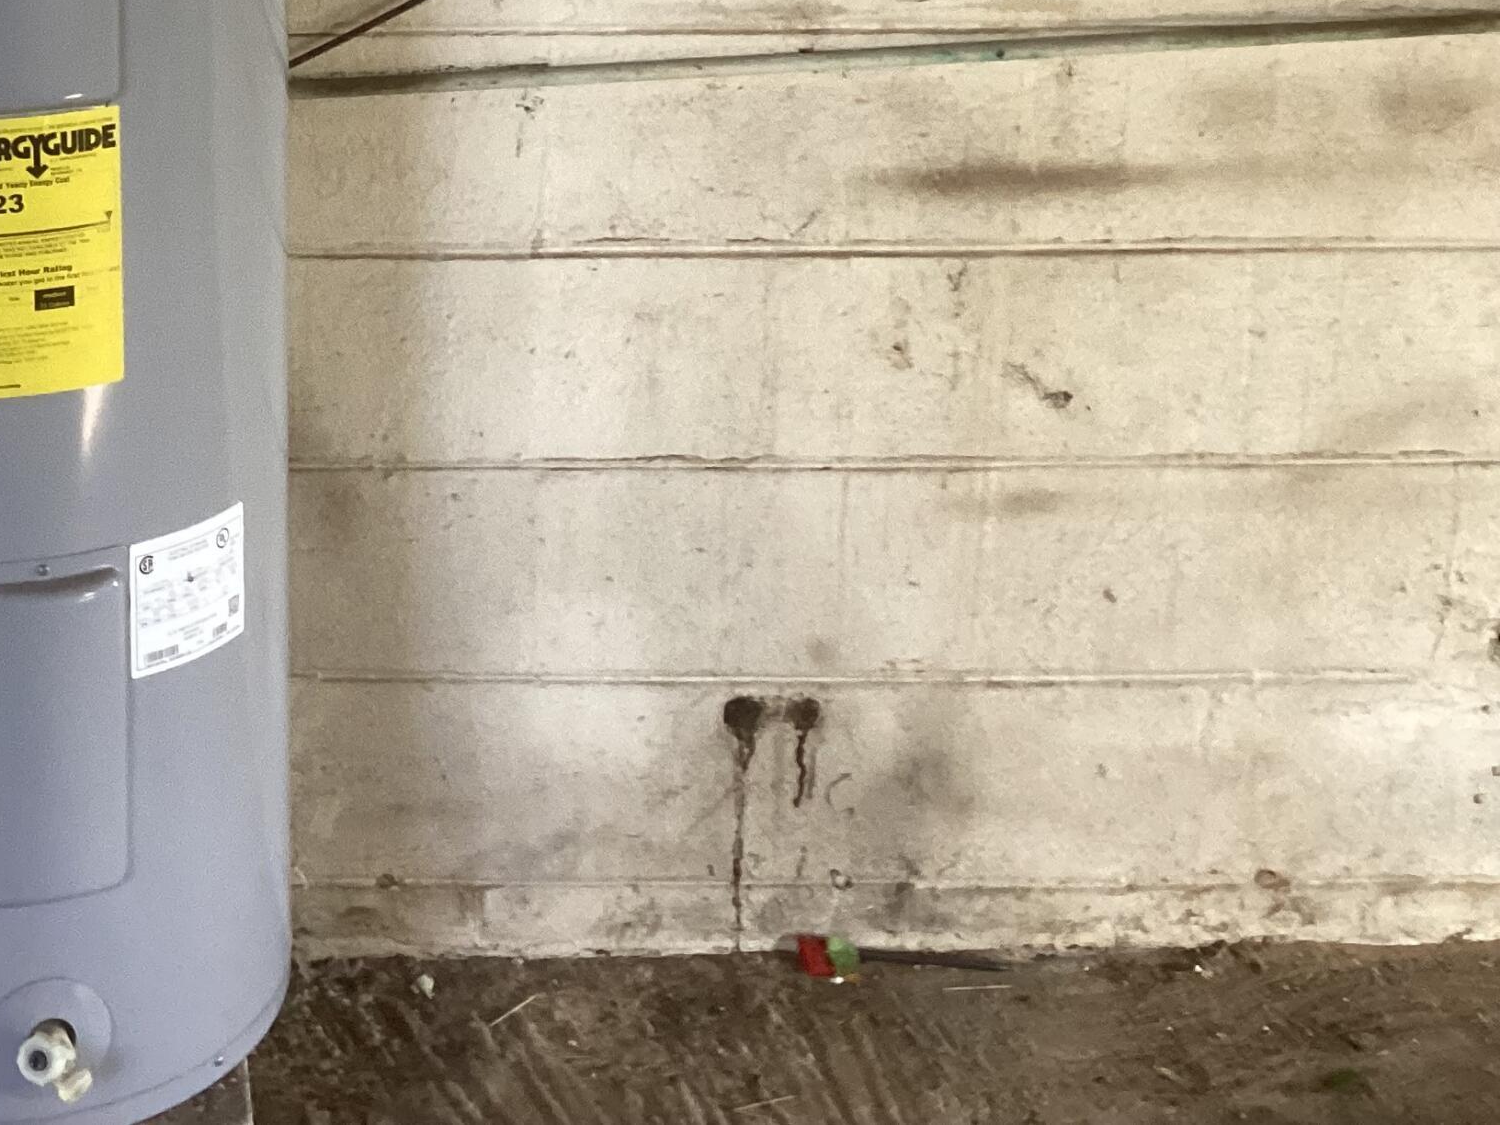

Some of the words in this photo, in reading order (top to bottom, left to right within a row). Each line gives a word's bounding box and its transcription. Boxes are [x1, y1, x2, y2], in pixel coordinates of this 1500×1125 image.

[30, 179, 53, 187] Energy
[18, 268, 41, 276] Hour
[43, 265, 72, 273] Rating
